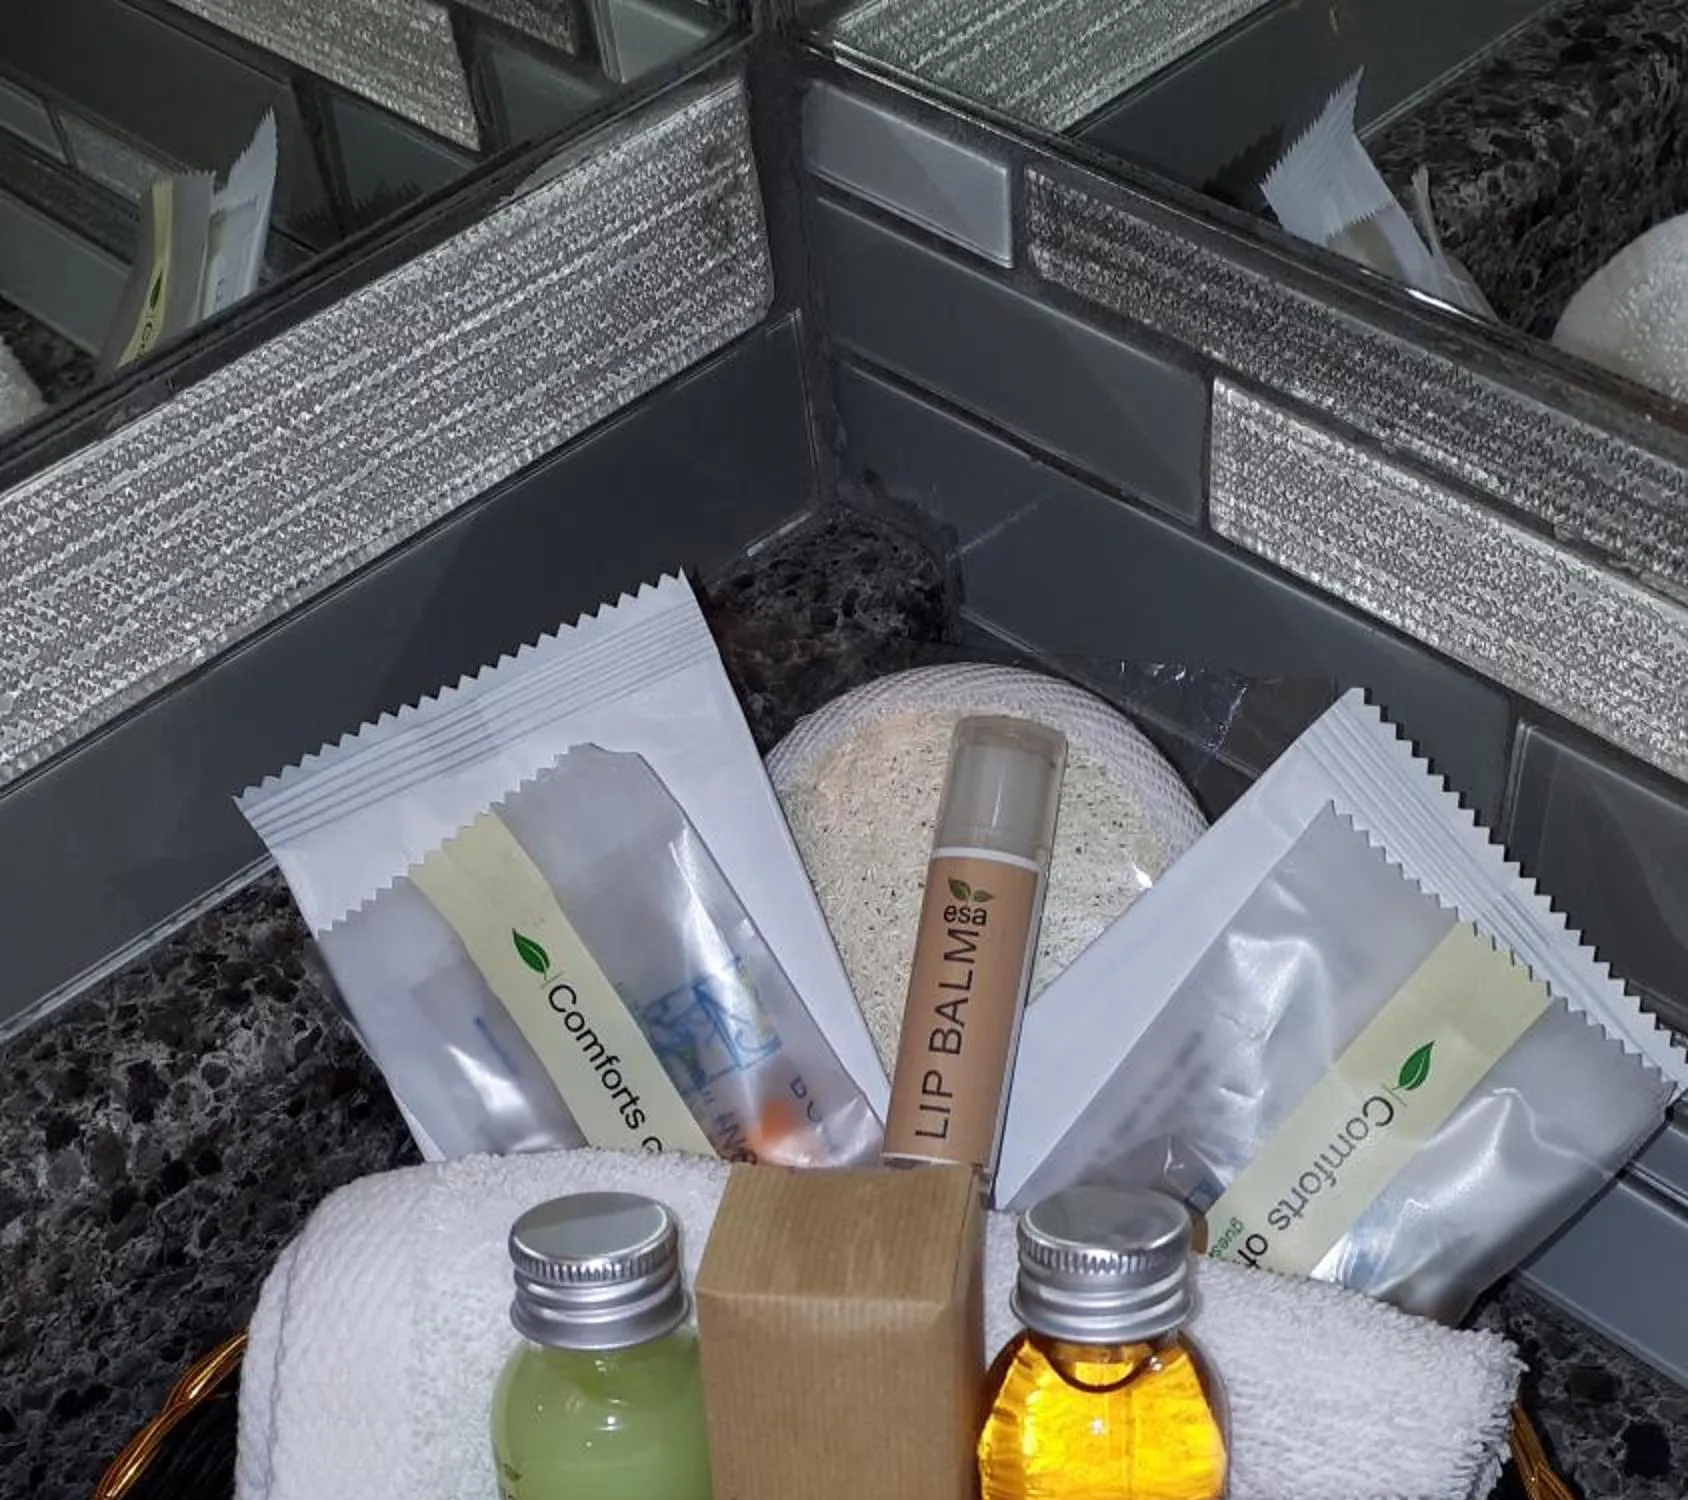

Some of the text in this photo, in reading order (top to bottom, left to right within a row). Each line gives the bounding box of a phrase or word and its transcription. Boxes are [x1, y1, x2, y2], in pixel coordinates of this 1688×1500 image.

[943, 904, 987, 927] esa
[547, 983, 647, 1131] Comforts
[914, 928, 980, 1140] LIP BALM
[1266, 1094, 1395, 1231] Comforts
